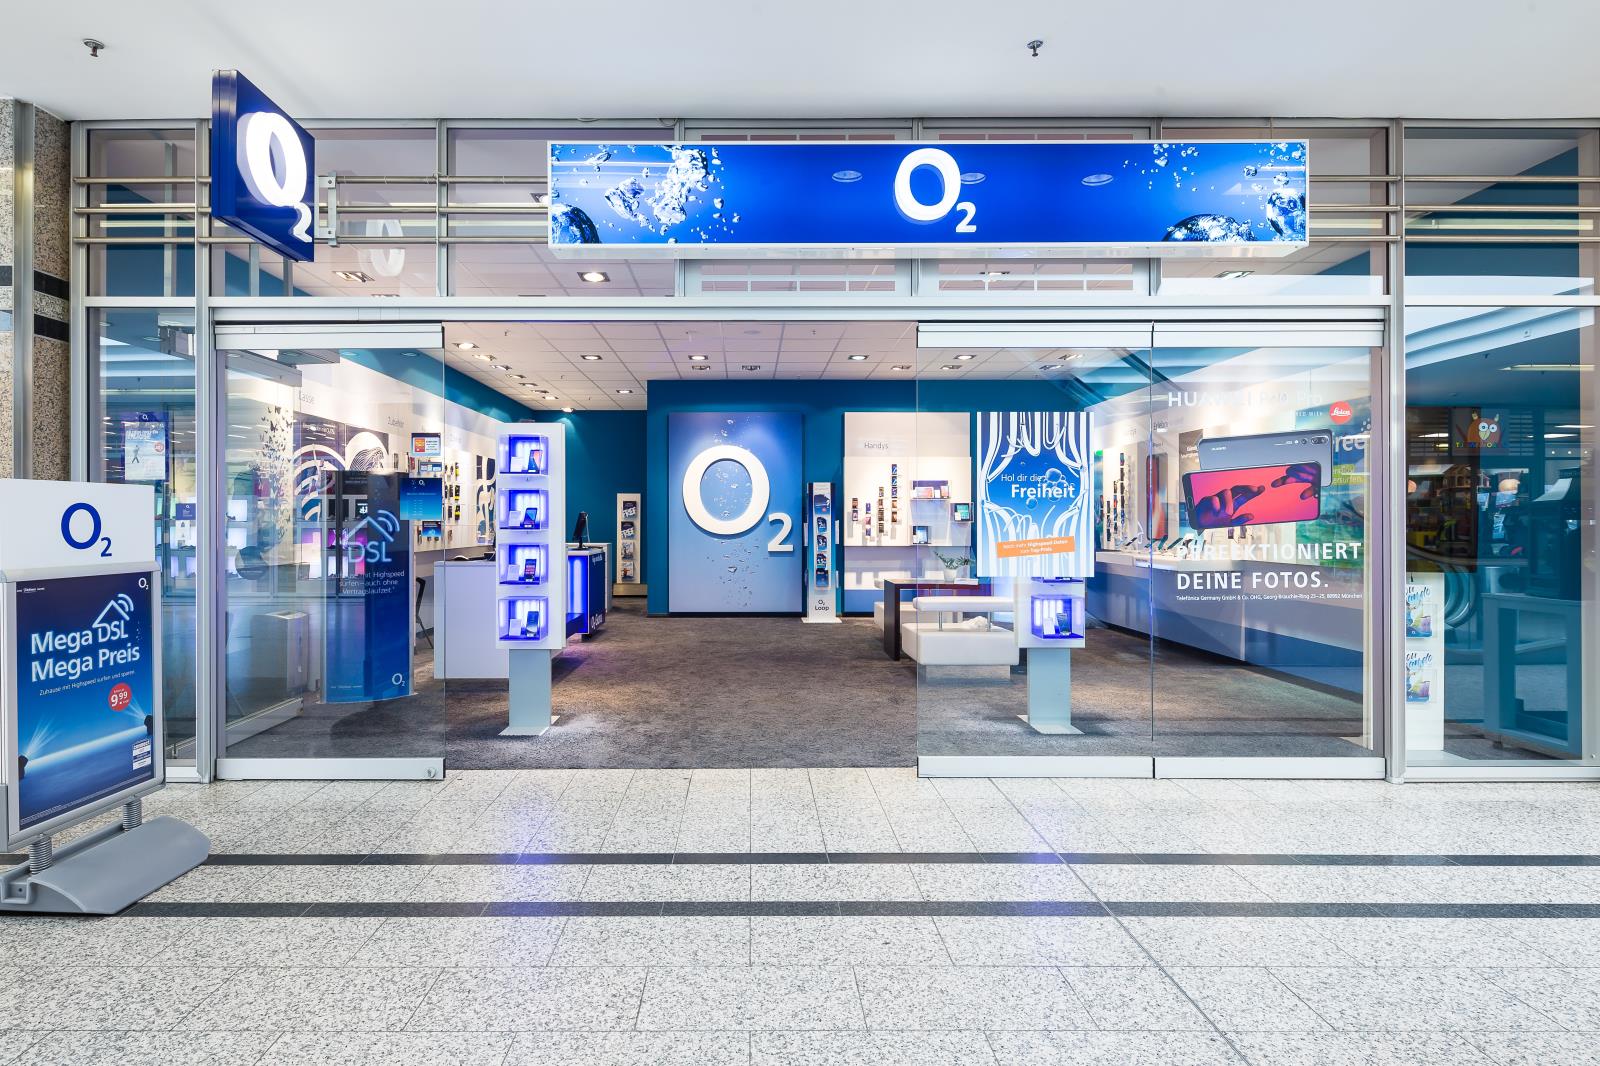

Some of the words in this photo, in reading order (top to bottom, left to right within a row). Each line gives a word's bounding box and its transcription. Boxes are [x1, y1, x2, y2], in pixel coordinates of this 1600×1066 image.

[237, 111, 312, 242] O2
[894, 147, 977, 233] O2
[863, 441, 889, 451] Handys
[1001, 473, 1015, 482] Hol
[1016, 473, 1028, 482] dir
[1029, 473, 1042, 482] die
[682, 444, 794, 552] O2
[1011, 483, 1076, 498] Freiheit
[60, 502, 113, 558] O2
[348, 541, 392, 563] DSL
[1177, 572, 1242, 590] DEINE
[1252, 570, 1329, 589] FOTOS.
[31, 630, 93, 655] Mega
[98, 619, 129, 643] DSL
[31, 656, 93, 682] Mega
[98, 643, 140, 668] Preis
[39, 686, 61, 696] Zuhause
[61, 683, 71, 691] mit
[71, 678, 97, 689] Highspeed
[391, 672, 406, 687] O2
